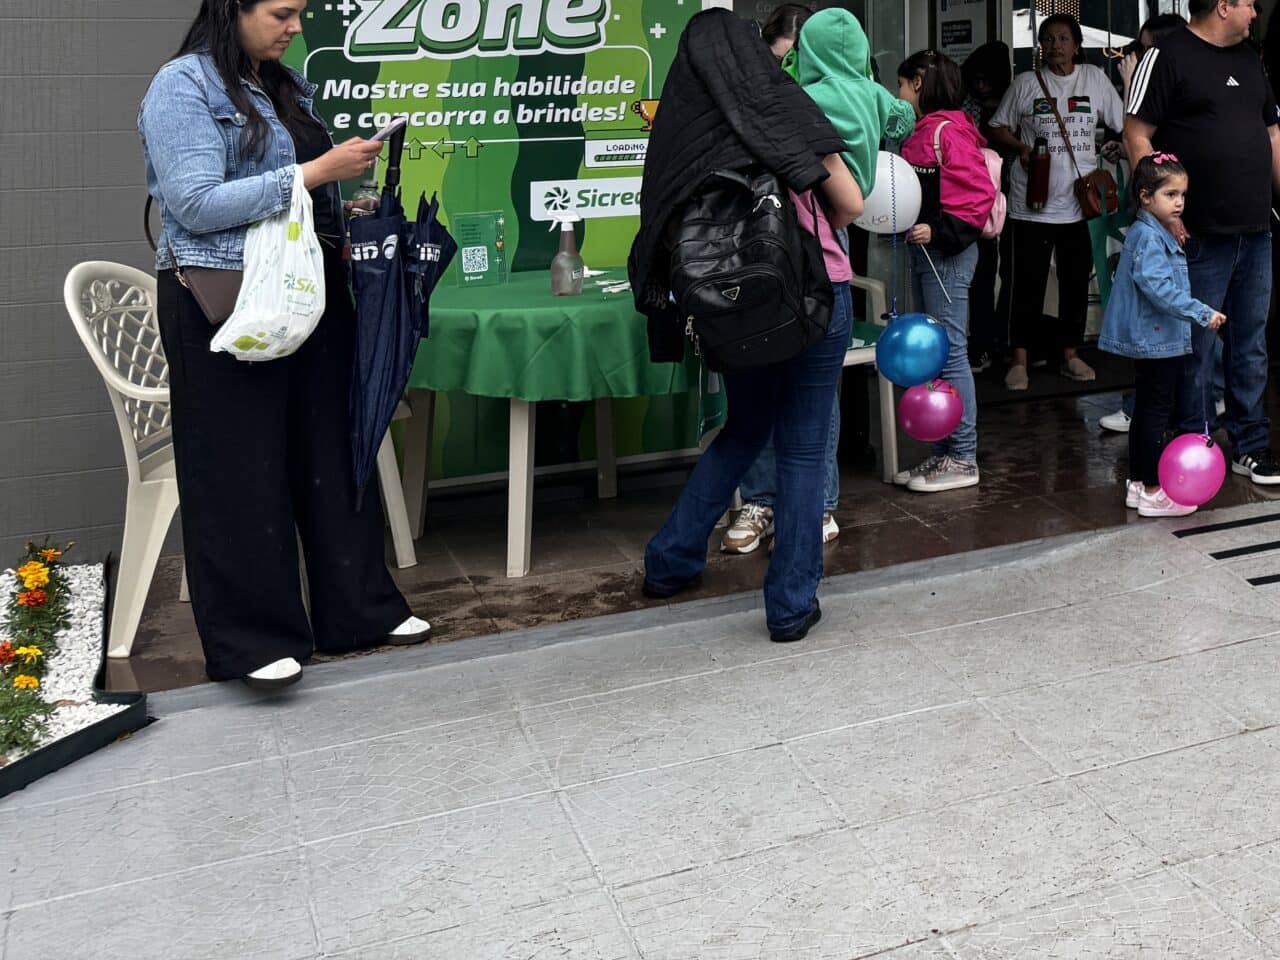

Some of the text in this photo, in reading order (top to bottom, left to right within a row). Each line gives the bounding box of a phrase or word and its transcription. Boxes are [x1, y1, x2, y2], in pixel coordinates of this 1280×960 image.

[322, 75, 636, 100] Mostre sua habilidade
[333, 102, 627, 129] e concorra a brindes!
